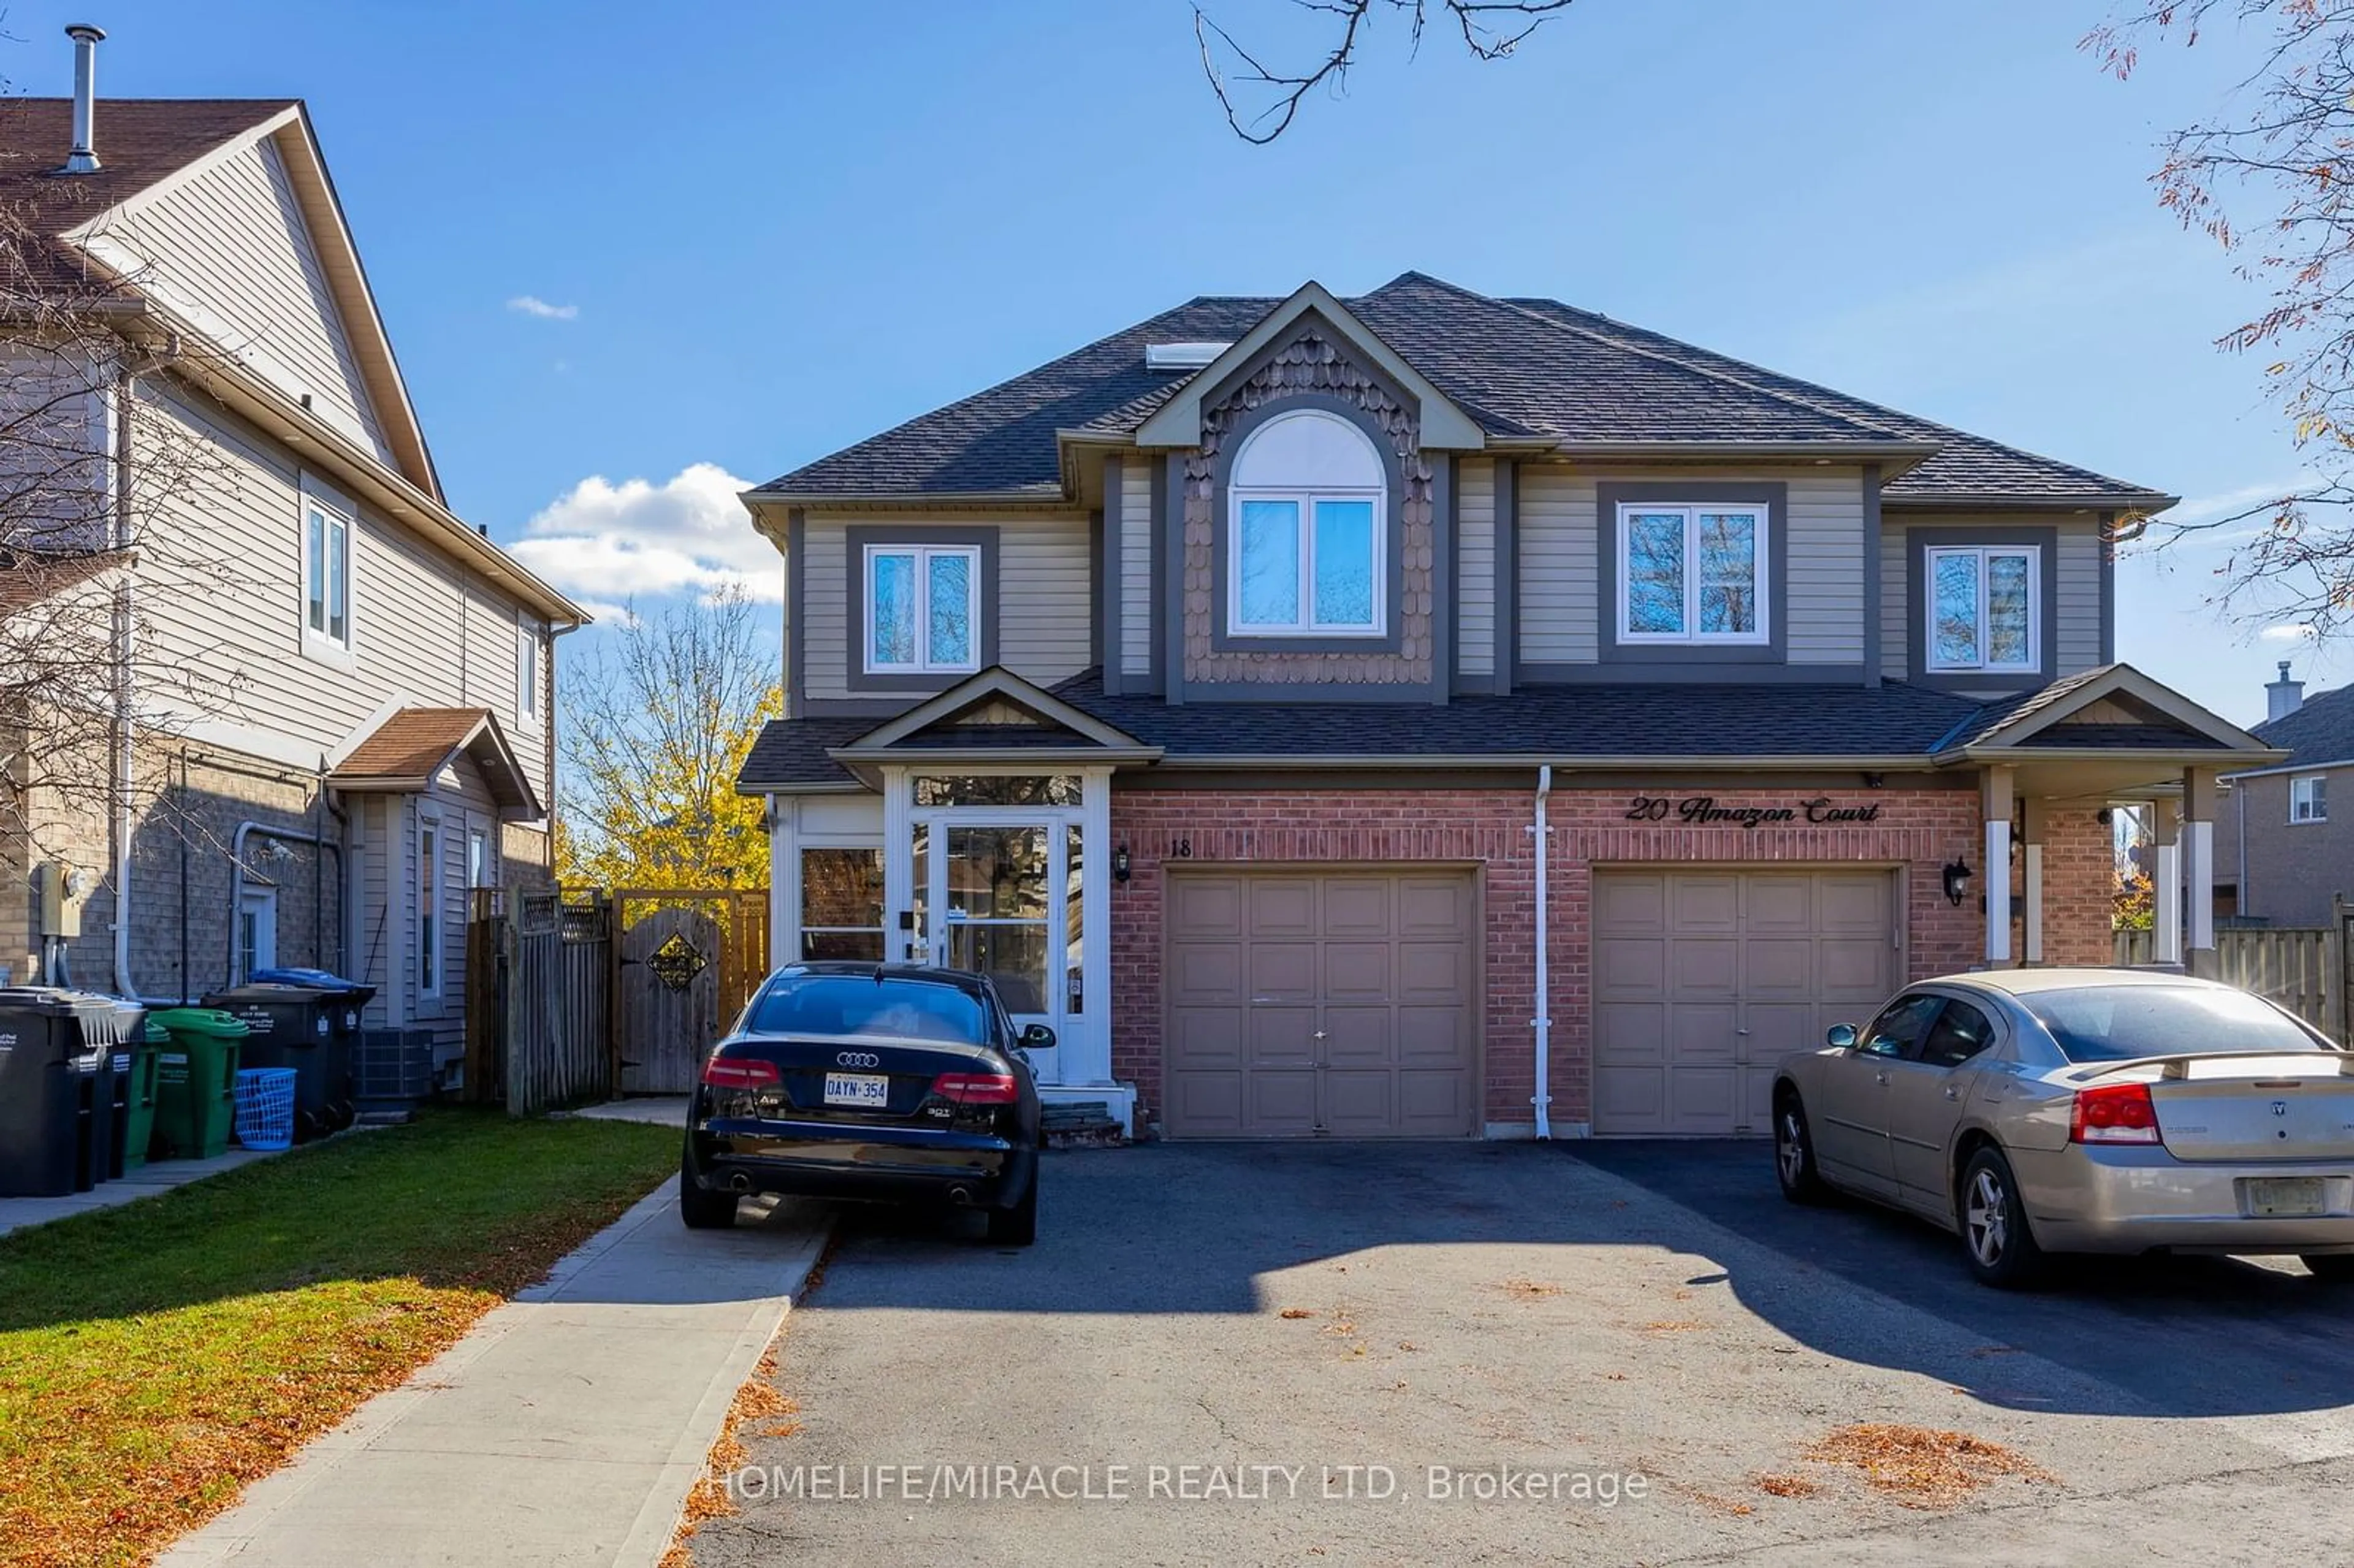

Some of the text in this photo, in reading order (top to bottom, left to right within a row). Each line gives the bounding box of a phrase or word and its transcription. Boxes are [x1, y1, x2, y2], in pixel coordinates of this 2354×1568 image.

[1625, 797, 1879, 828] 20 Amazon Court
[1171, 839, 1191, 858] 18
